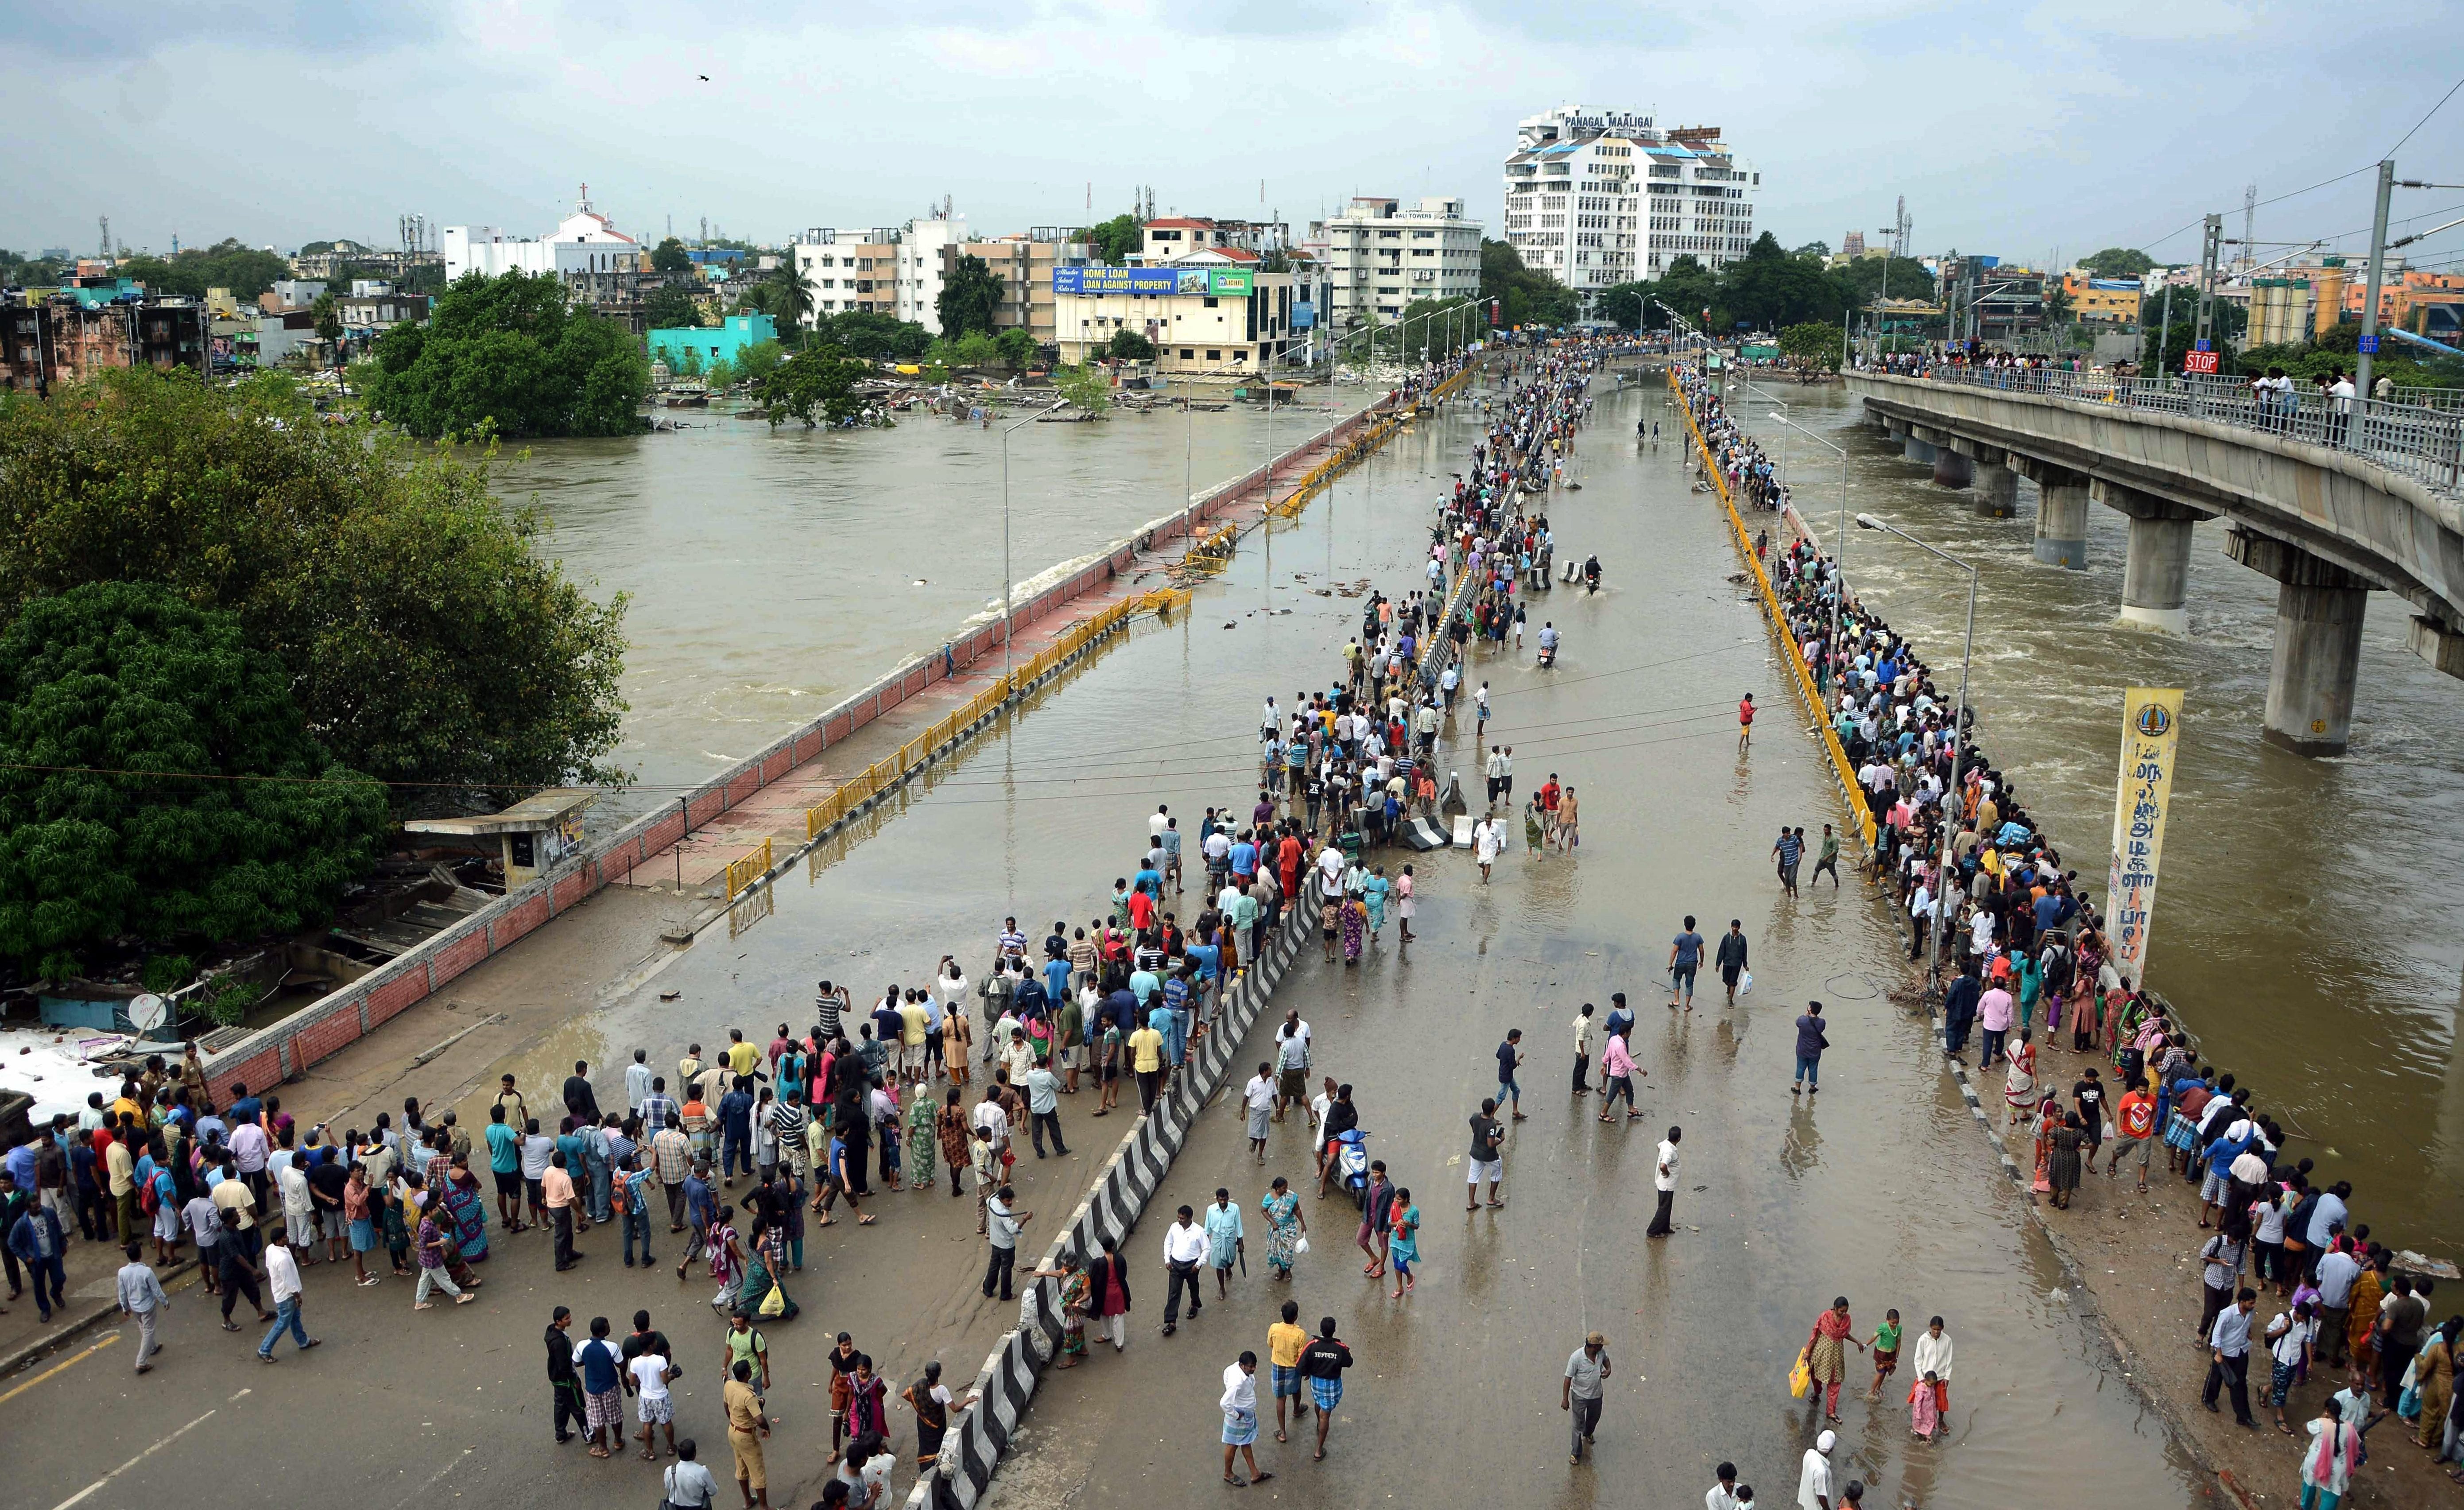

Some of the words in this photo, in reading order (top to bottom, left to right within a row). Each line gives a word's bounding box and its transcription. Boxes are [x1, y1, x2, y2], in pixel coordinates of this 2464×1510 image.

[1565, 116, 1604, 127] PANAGAL
[1608, 116, 1653, 127] MAALIGAI
[1083, 269, 1106, 278] HOME
[1108, 269, 1128, 279] LOAN
[1083, 279, 1100, 289] LOAN
[1103, 280, 1132, 289] AGAINST
[1134, 280, 1171, 290] PROPERTY
[2186, 354, 2216, 369] STOP
